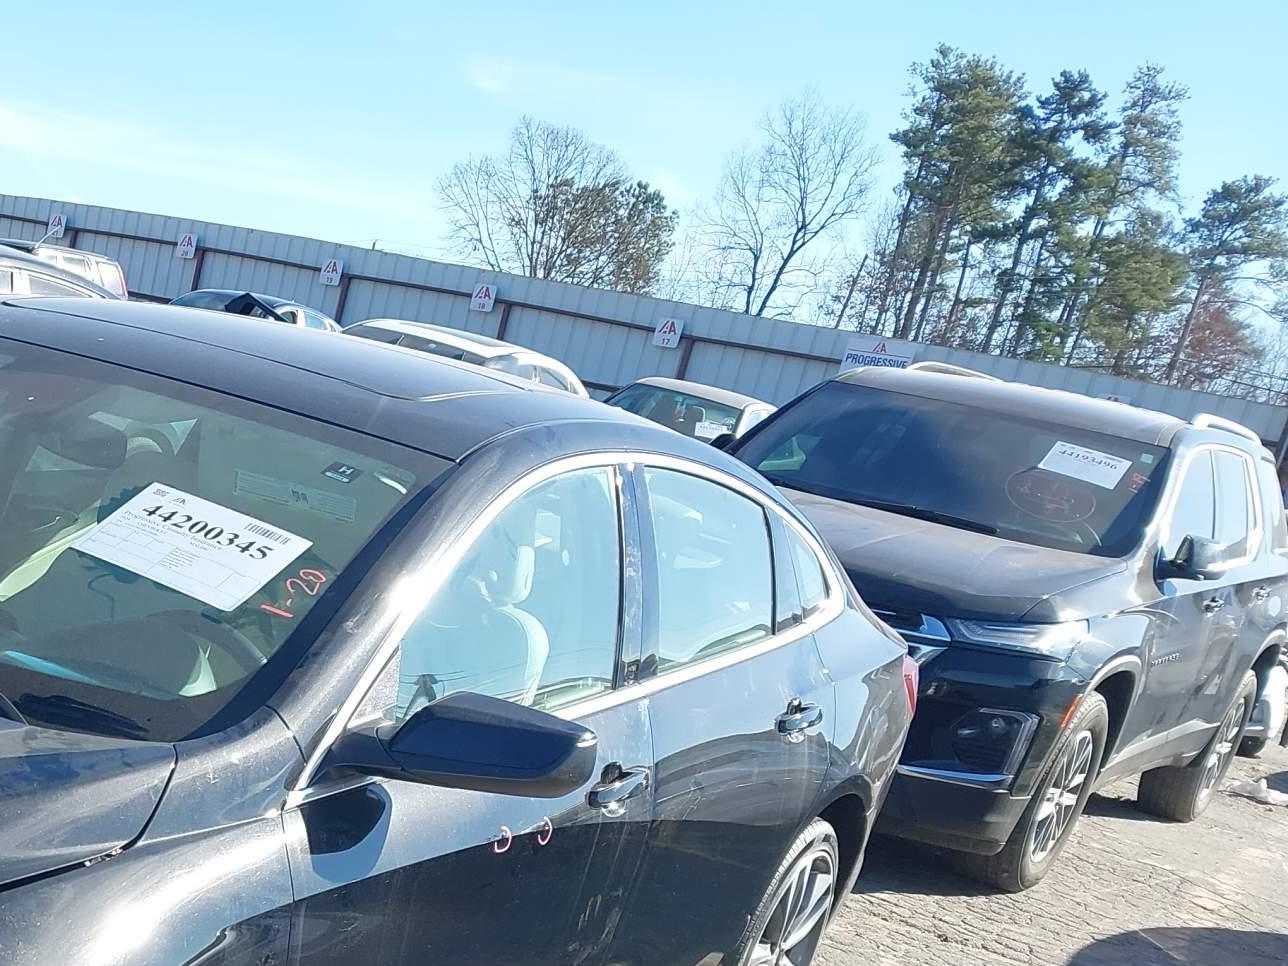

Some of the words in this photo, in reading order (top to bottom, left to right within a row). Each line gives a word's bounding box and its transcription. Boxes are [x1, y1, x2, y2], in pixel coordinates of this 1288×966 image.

[844, 352, 909, 370] PROGRESSIVE
[123, 510, 162, 527] Progressive
[190, 535, 224, 551] Insurance
[141, 504, 274, 560] 44200345
